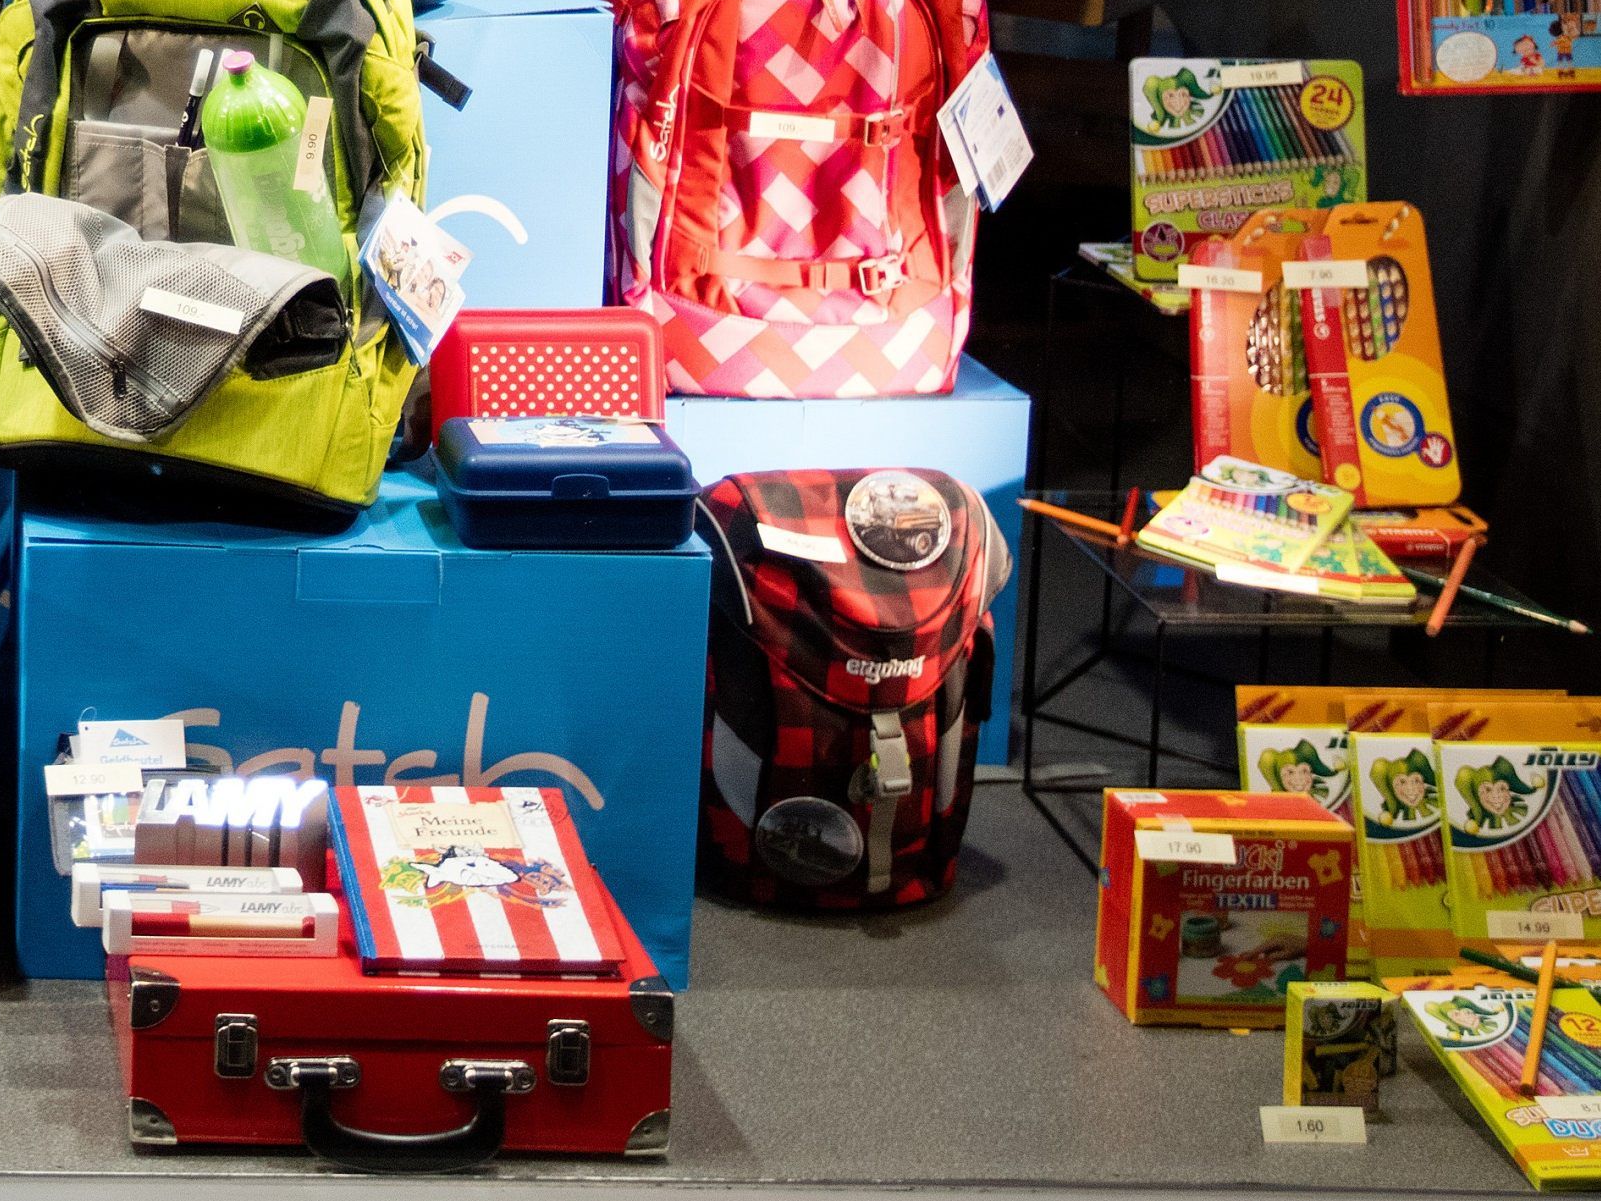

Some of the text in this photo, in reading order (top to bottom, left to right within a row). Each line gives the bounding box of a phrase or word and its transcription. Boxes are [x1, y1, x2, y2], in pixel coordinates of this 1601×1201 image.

[1311, 84, 1343, 106] 24
[650, 83, 681, 163] Satch
[305, 133, 318, 160] 9.90
[1144, 180, 1295, 215] SUPERSTICKS
[846, 655, 927, 685] ergobag
[72, 773, 106, 785] 12.90
[137, 776, 329, 828] LAMY
[420, 816, 484, 826] Meine
[414, 827, 499, 838] Freunde
[206, 876, 247, 888] LAMY
[1181, 870, 1310, 891] Fingerfarben
[240, 901, 304, 914] LAMY abc
[1216, 893, 1278, 910] TEXTIL
[1297, 1119, 1324, 1133] 1.60
